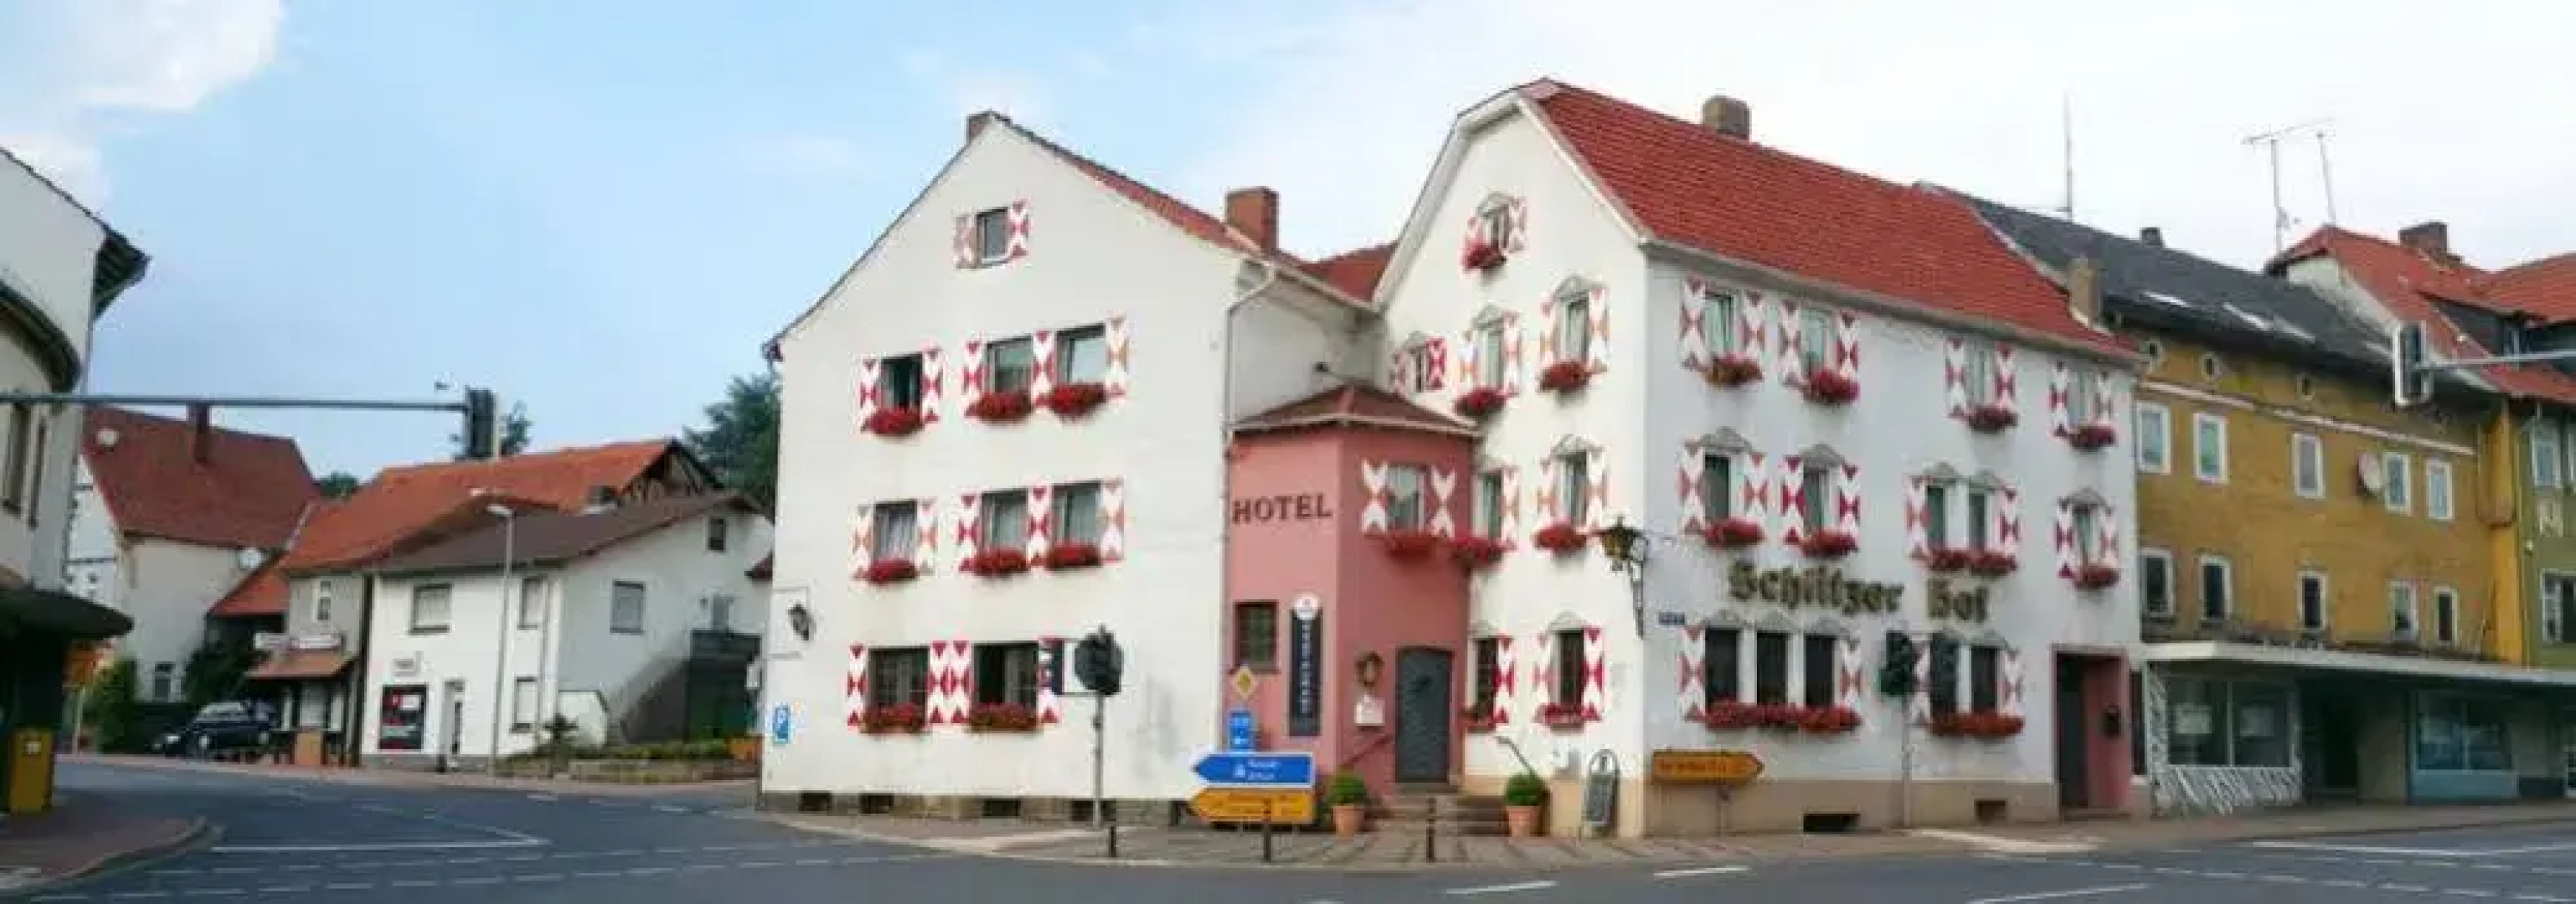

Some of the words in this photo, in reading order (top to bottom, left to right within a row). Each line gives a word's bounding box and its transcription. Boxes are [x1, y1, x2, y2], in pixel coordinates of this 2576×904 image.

[1232, 493, 1333, 524] HOTEL
[1728, 561, 1905, 616] Schlitzer
[1925, 577, 1990, 623] Hof
